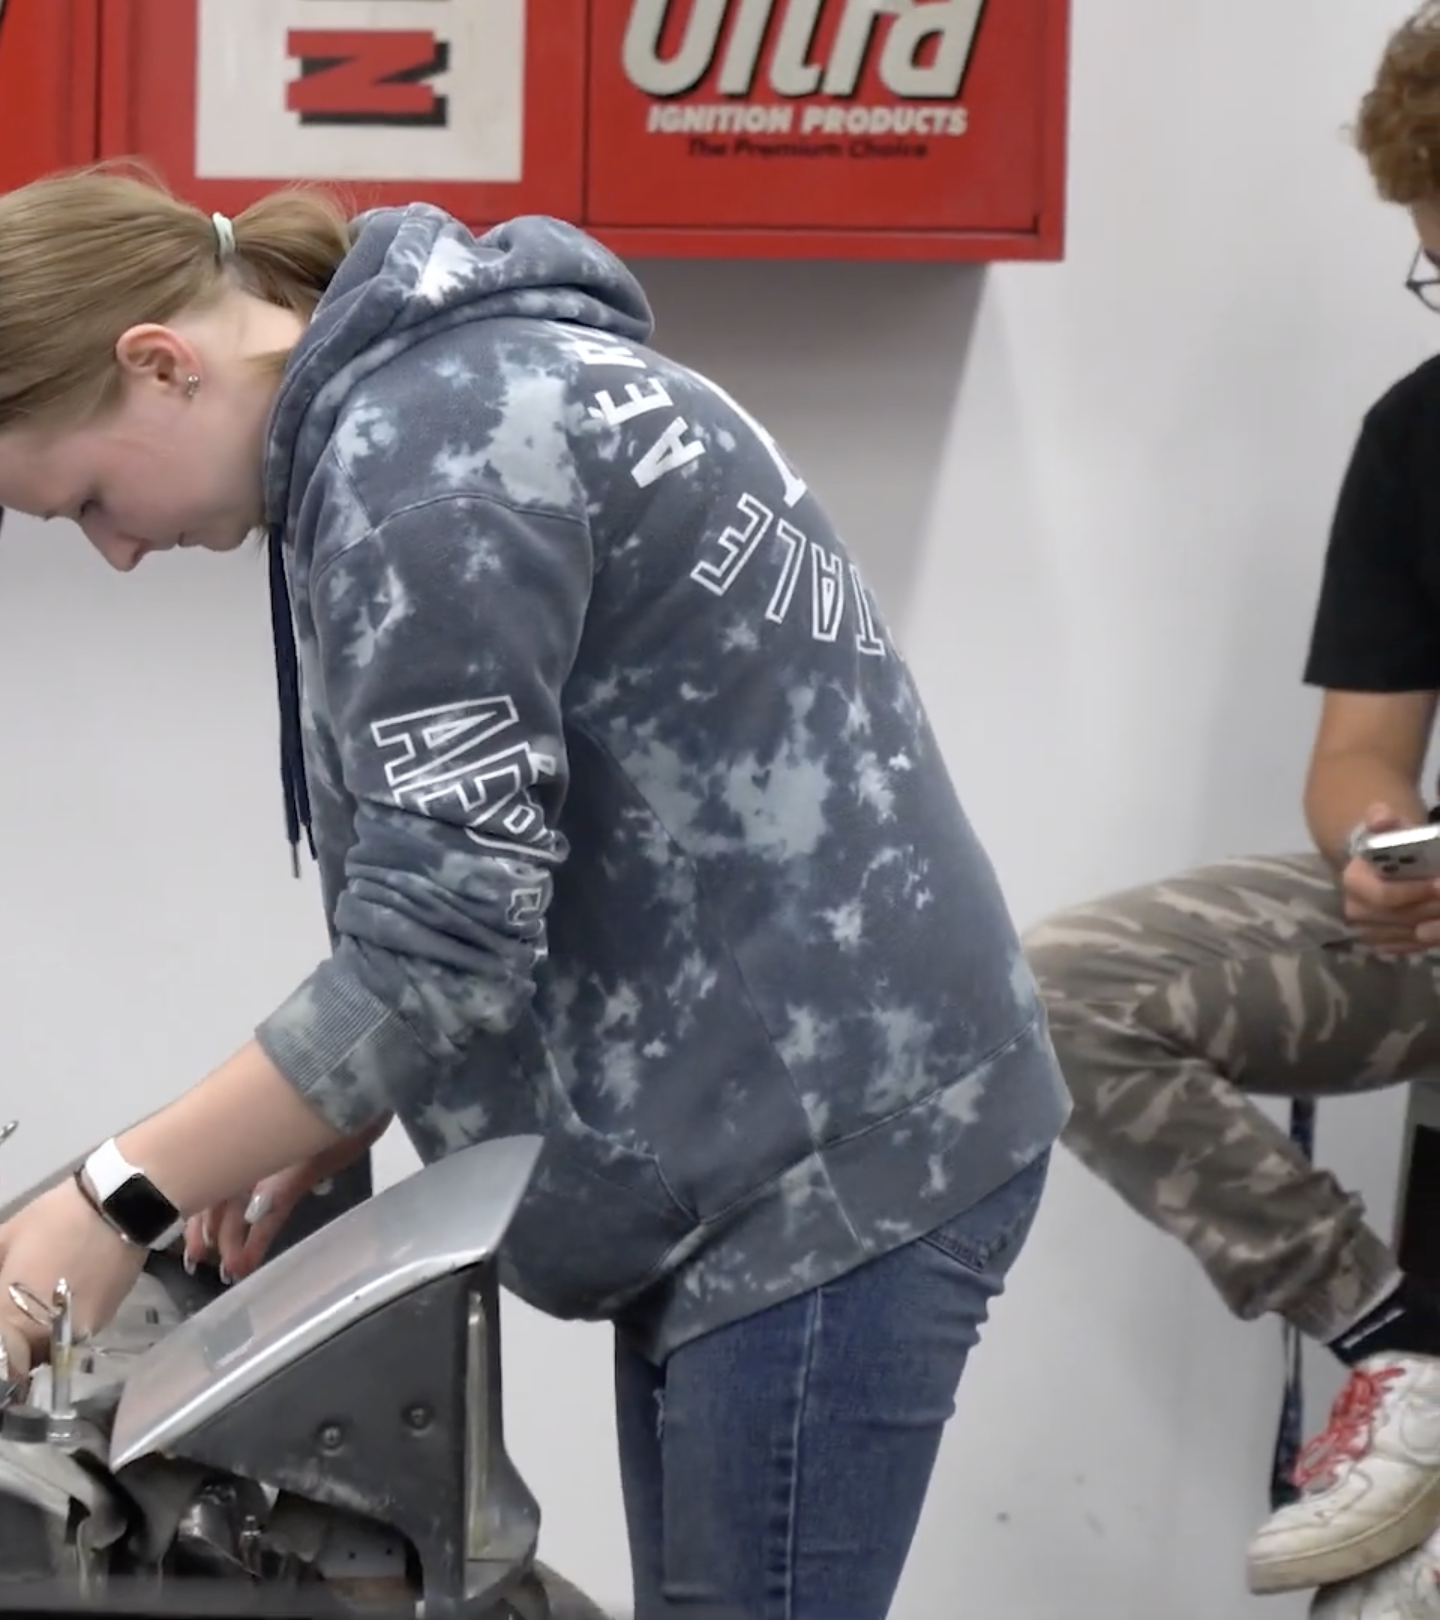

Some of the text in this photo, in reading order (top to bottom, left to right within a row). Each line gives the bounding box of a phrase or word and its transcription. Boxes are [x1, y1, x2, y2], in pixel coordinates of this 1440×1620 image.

[622, 0, 984, 100] Ultra
[646, 104, 967, 135] IGNITION PRODUCTS
[687, 138, 927, 159] The Premium Choice
